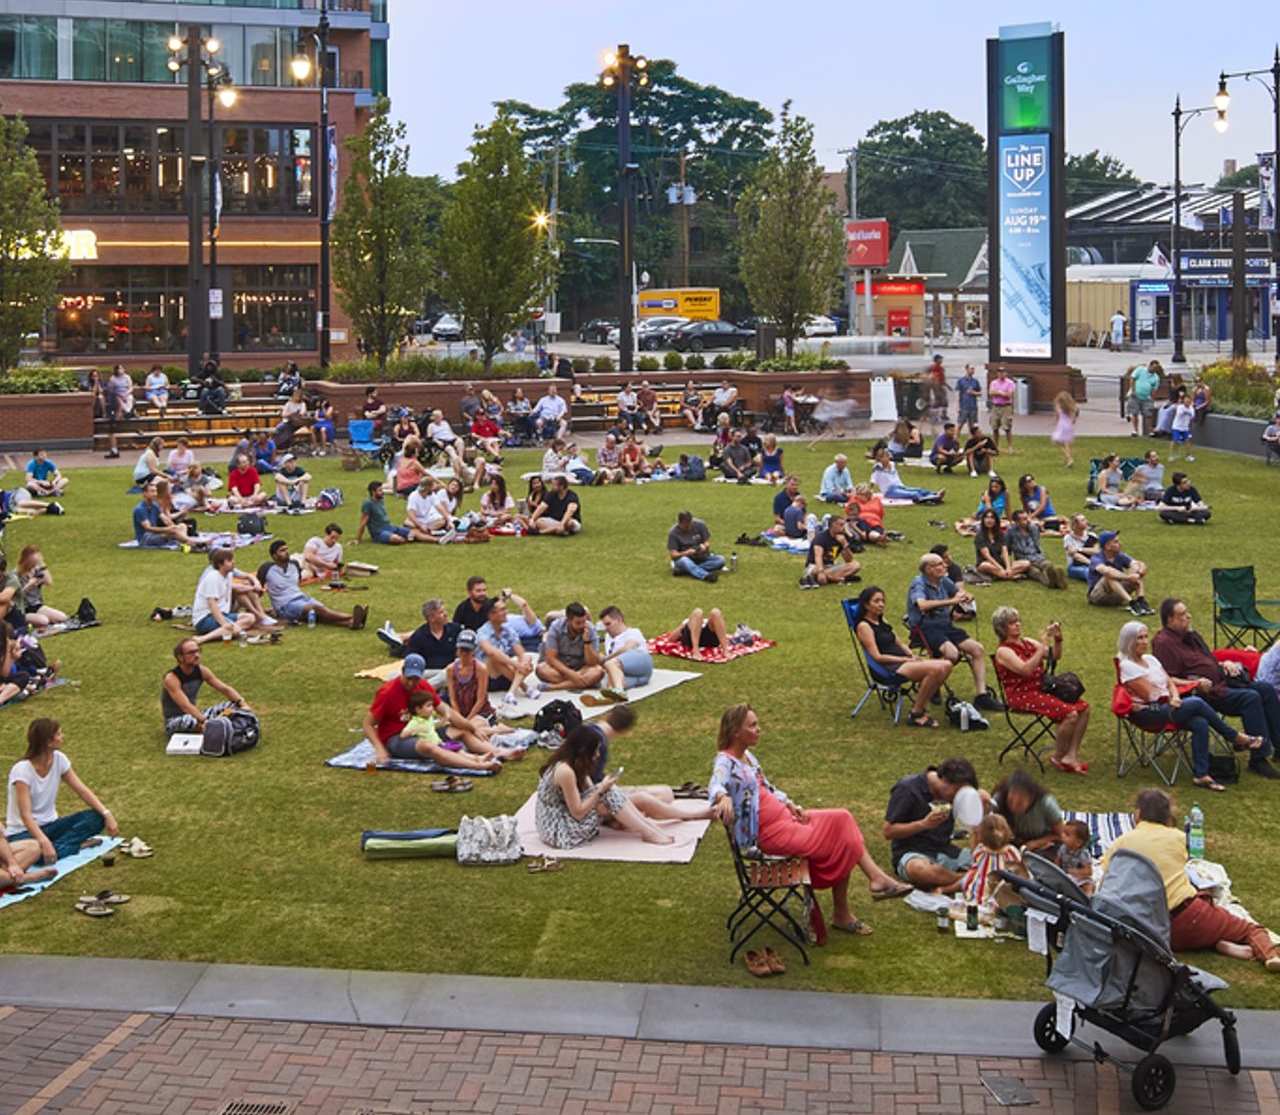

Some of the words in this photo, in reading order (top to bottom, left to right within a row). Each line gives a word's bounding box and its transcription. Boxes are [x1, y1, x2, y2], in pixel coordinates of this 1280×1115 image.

[1007, 153, 1042, 168] LINE
[1014, 168, 1035, 181] UP
[1189, 258, 1211, 269] CLARK
